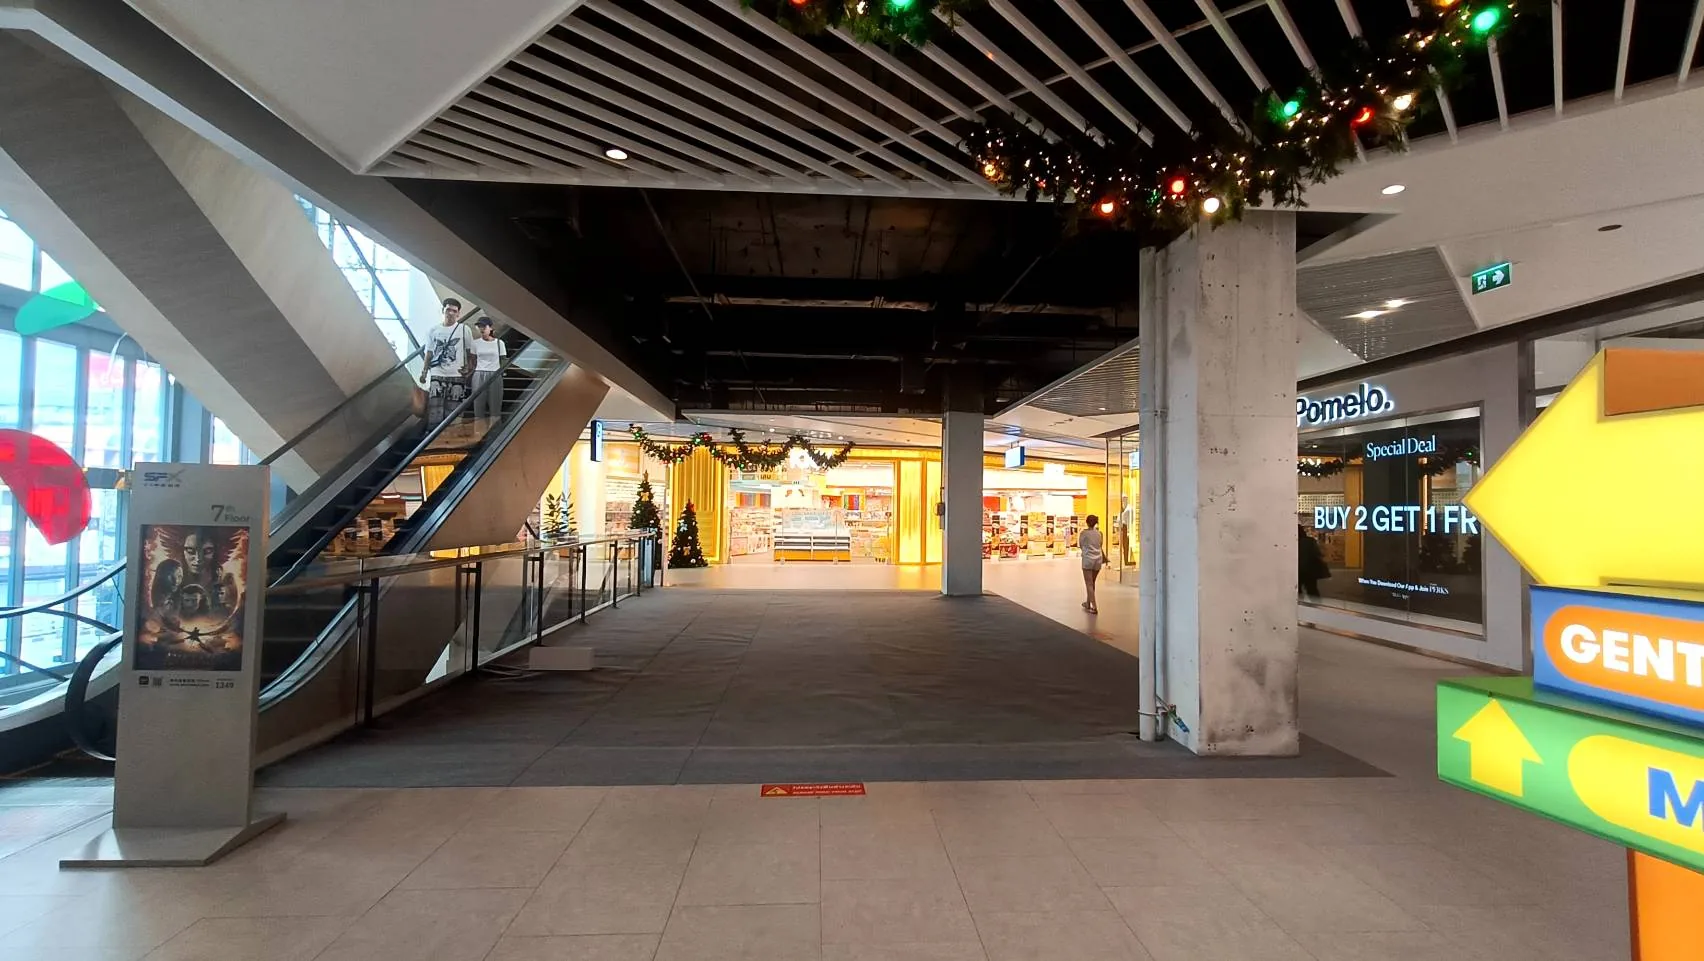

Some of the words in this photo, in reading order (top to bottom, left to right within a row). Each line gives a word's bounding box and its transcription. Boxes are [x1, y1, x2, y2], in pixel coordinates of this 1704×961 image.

[1297, 383, 1394, 427] Pomelo.
[1366, 437, 1406, 461] Special
[1407, 435, 1436, 454] Deal
[1313, 506, 1351, 530] BUY
[1354, 505, 1368, 531] 2
[1371, 505, 1421, 533] GET
[1426, 506, 1436, 533] 1
